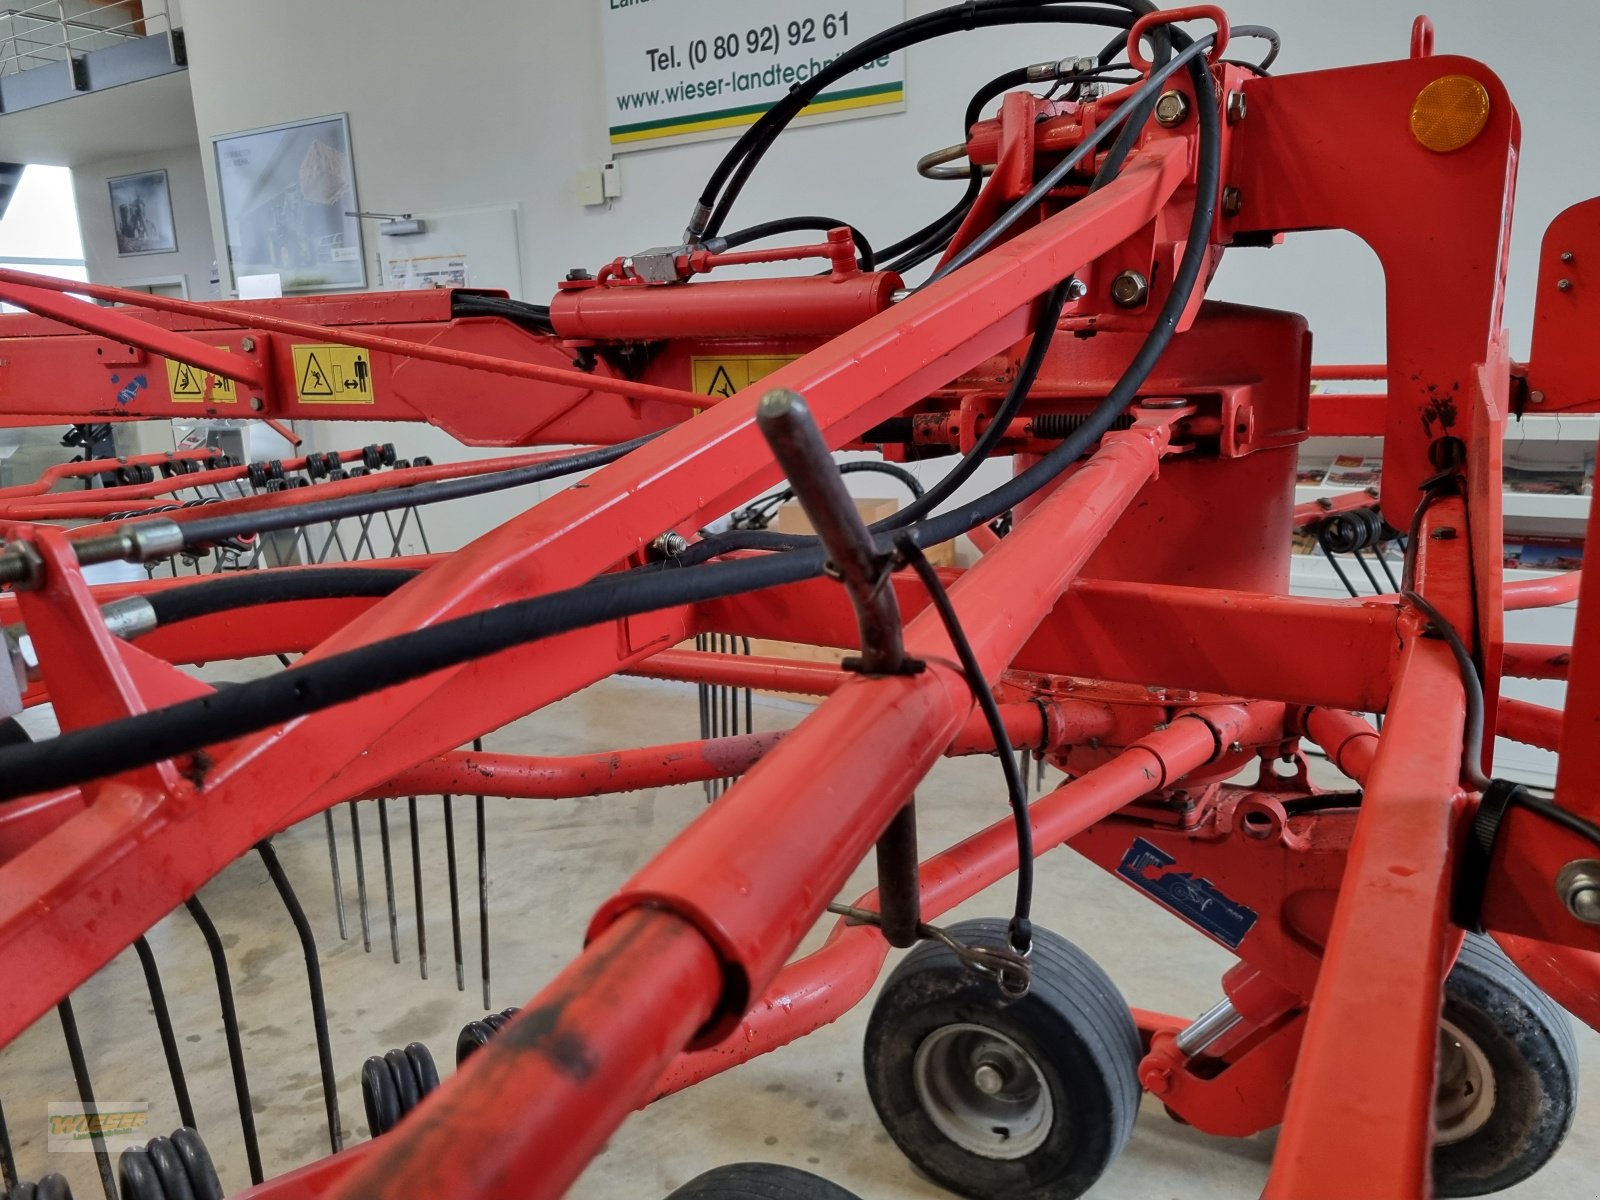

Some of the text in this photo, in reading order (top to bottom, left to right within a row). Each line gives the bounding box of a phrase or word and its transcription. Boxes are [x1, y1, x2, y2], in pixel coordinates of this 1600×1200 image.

[645, 11, 849, 72] Tel. (0 80 92) 92 61
